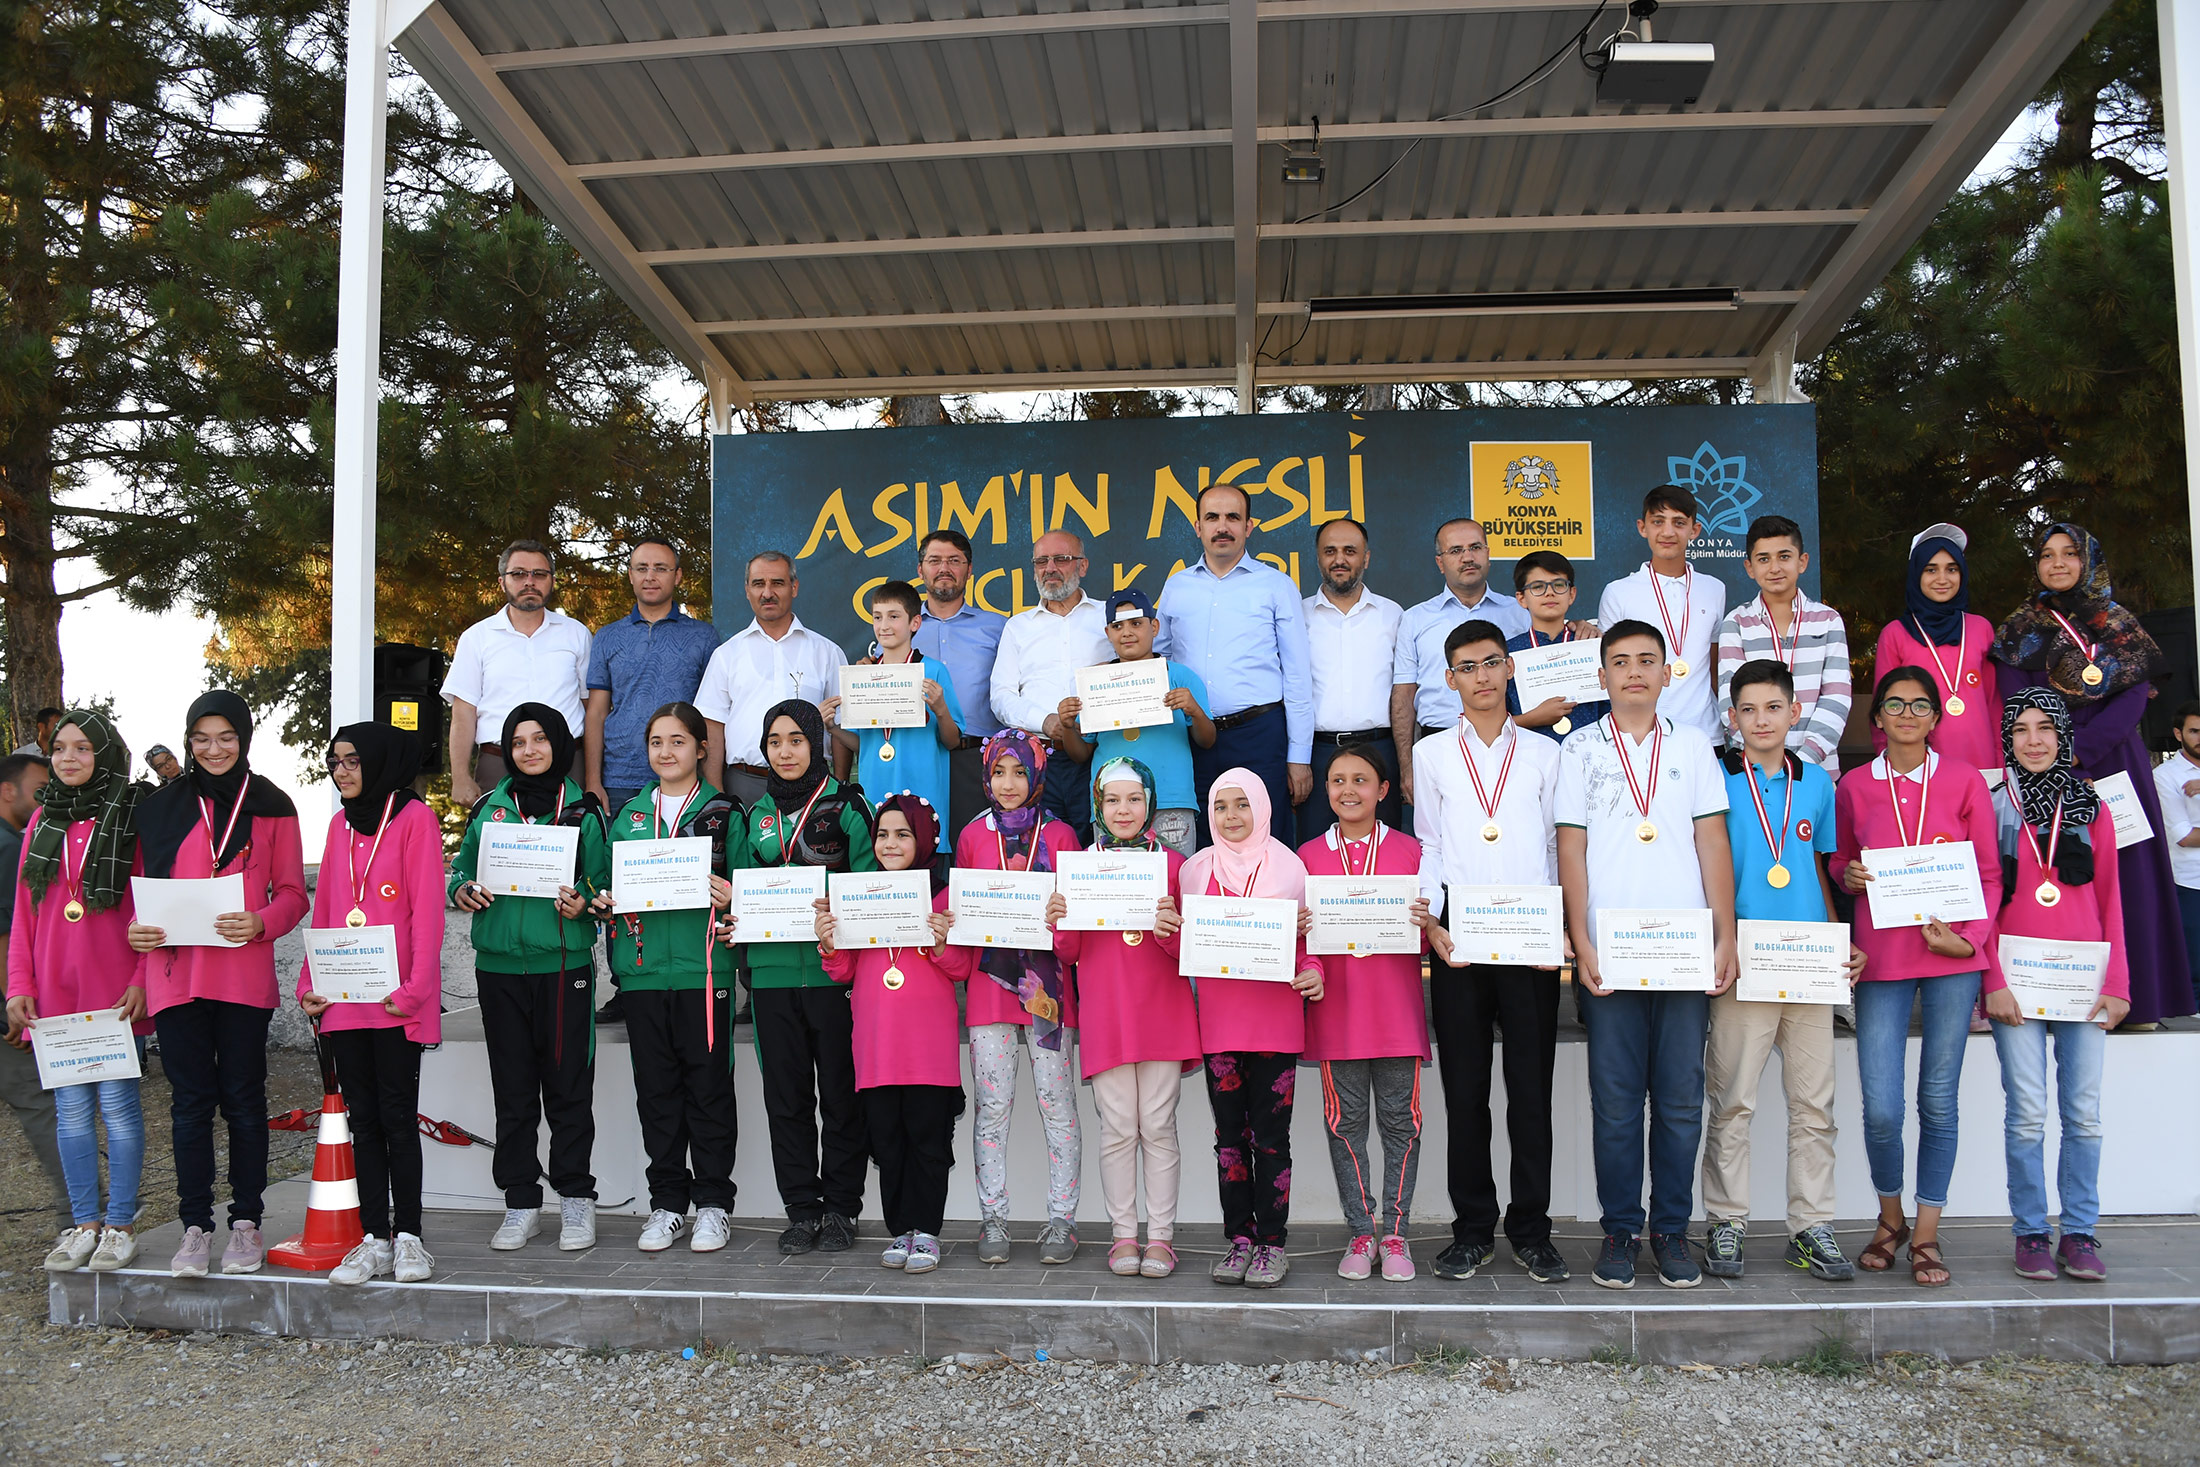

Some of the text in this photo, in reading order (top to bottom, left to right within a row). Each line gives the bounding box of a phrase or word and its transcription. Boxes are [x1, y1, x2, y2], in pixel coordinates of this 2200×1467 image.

[795, 431, 1366, 559] ASIM'IN NESLİ
[1508, 505, 1557, 518] KONYA
[1483, 518, 1583, 537] BÜYÜKŞEHİR
[1504, 535, 1563, 547] BELEDİYESİ
[1687, 538, 1733, 547] KONYA
